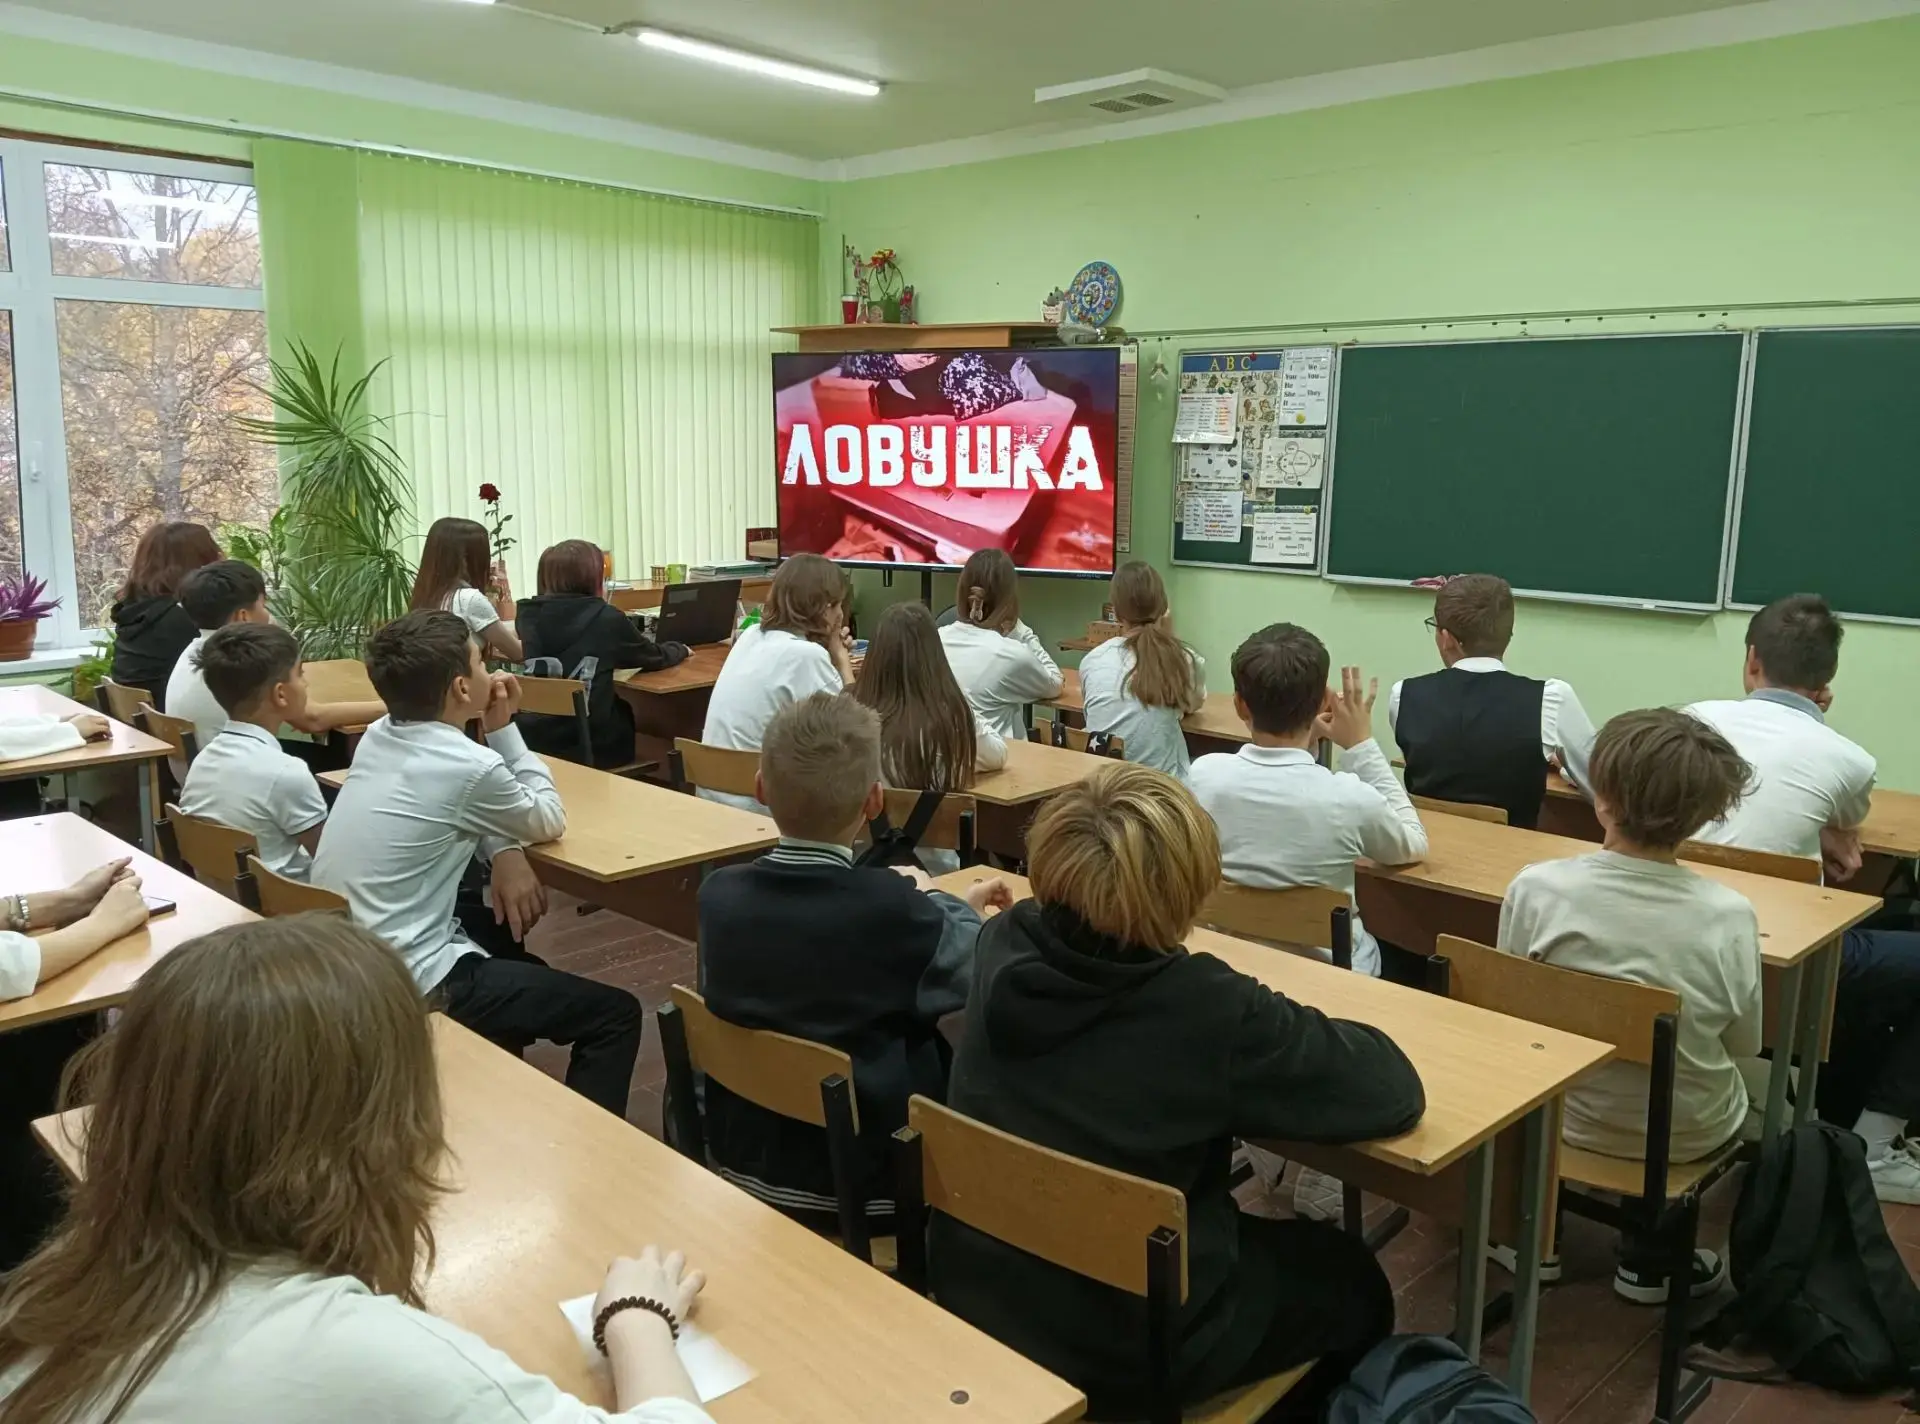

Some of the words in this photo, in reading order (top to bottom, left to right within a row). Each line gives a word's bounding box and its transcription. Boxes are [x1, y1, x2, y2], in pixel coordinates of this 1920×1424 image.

[1210, 358, 1220, 371] A
[1226, 356, 1235, 370] B
[782, 423, 1104, 490] ЛОВУШКА
